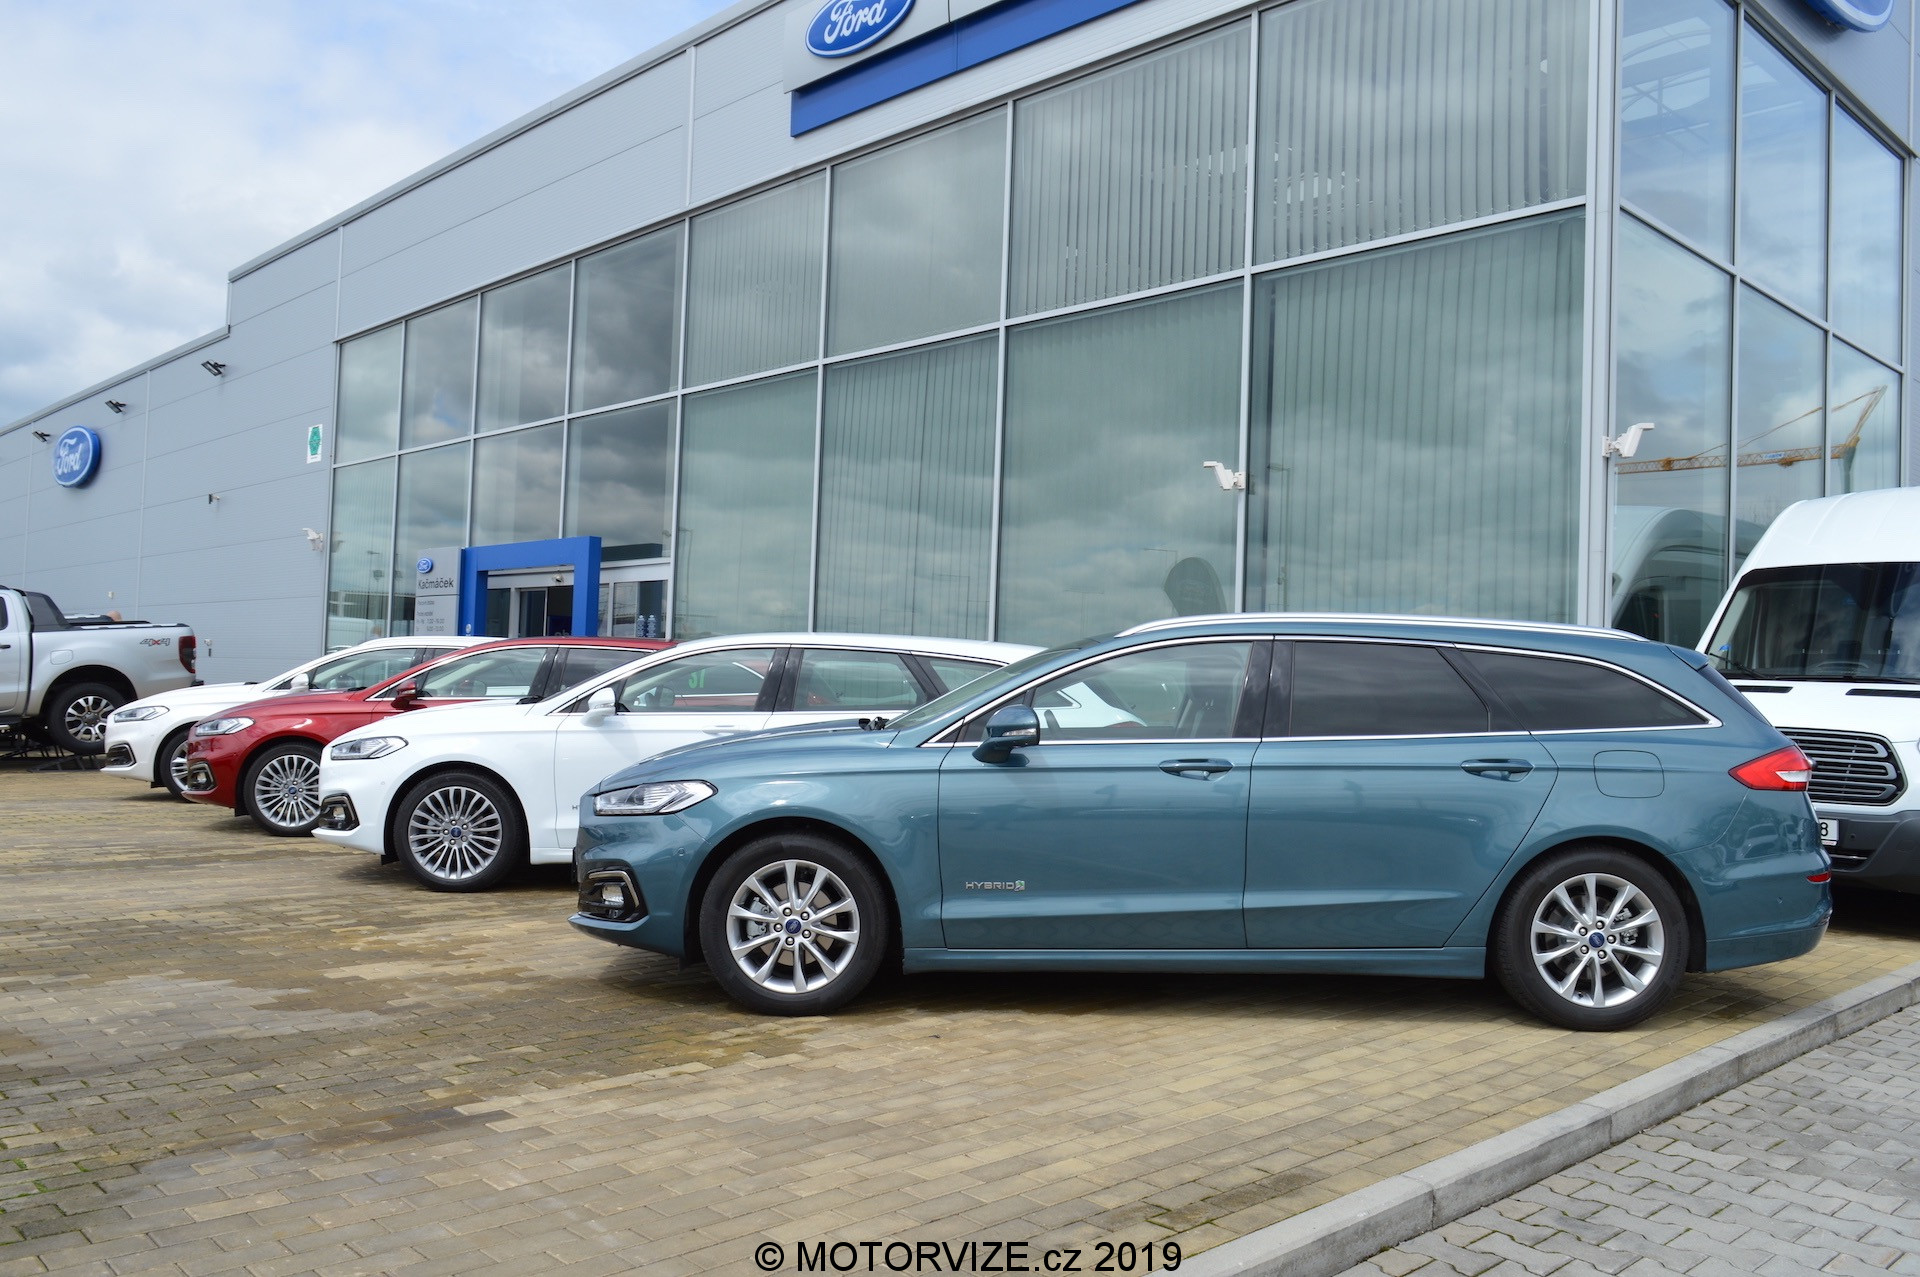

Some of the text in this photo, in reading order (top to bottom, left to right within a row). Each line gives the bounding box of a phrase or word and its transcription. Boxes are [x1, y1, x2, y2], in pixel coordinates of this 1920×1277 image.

[824, 0, 887, 44] Ford
[57, 437, 83, 475] Ford
[965, 881, 1015, 890] HYBRID
